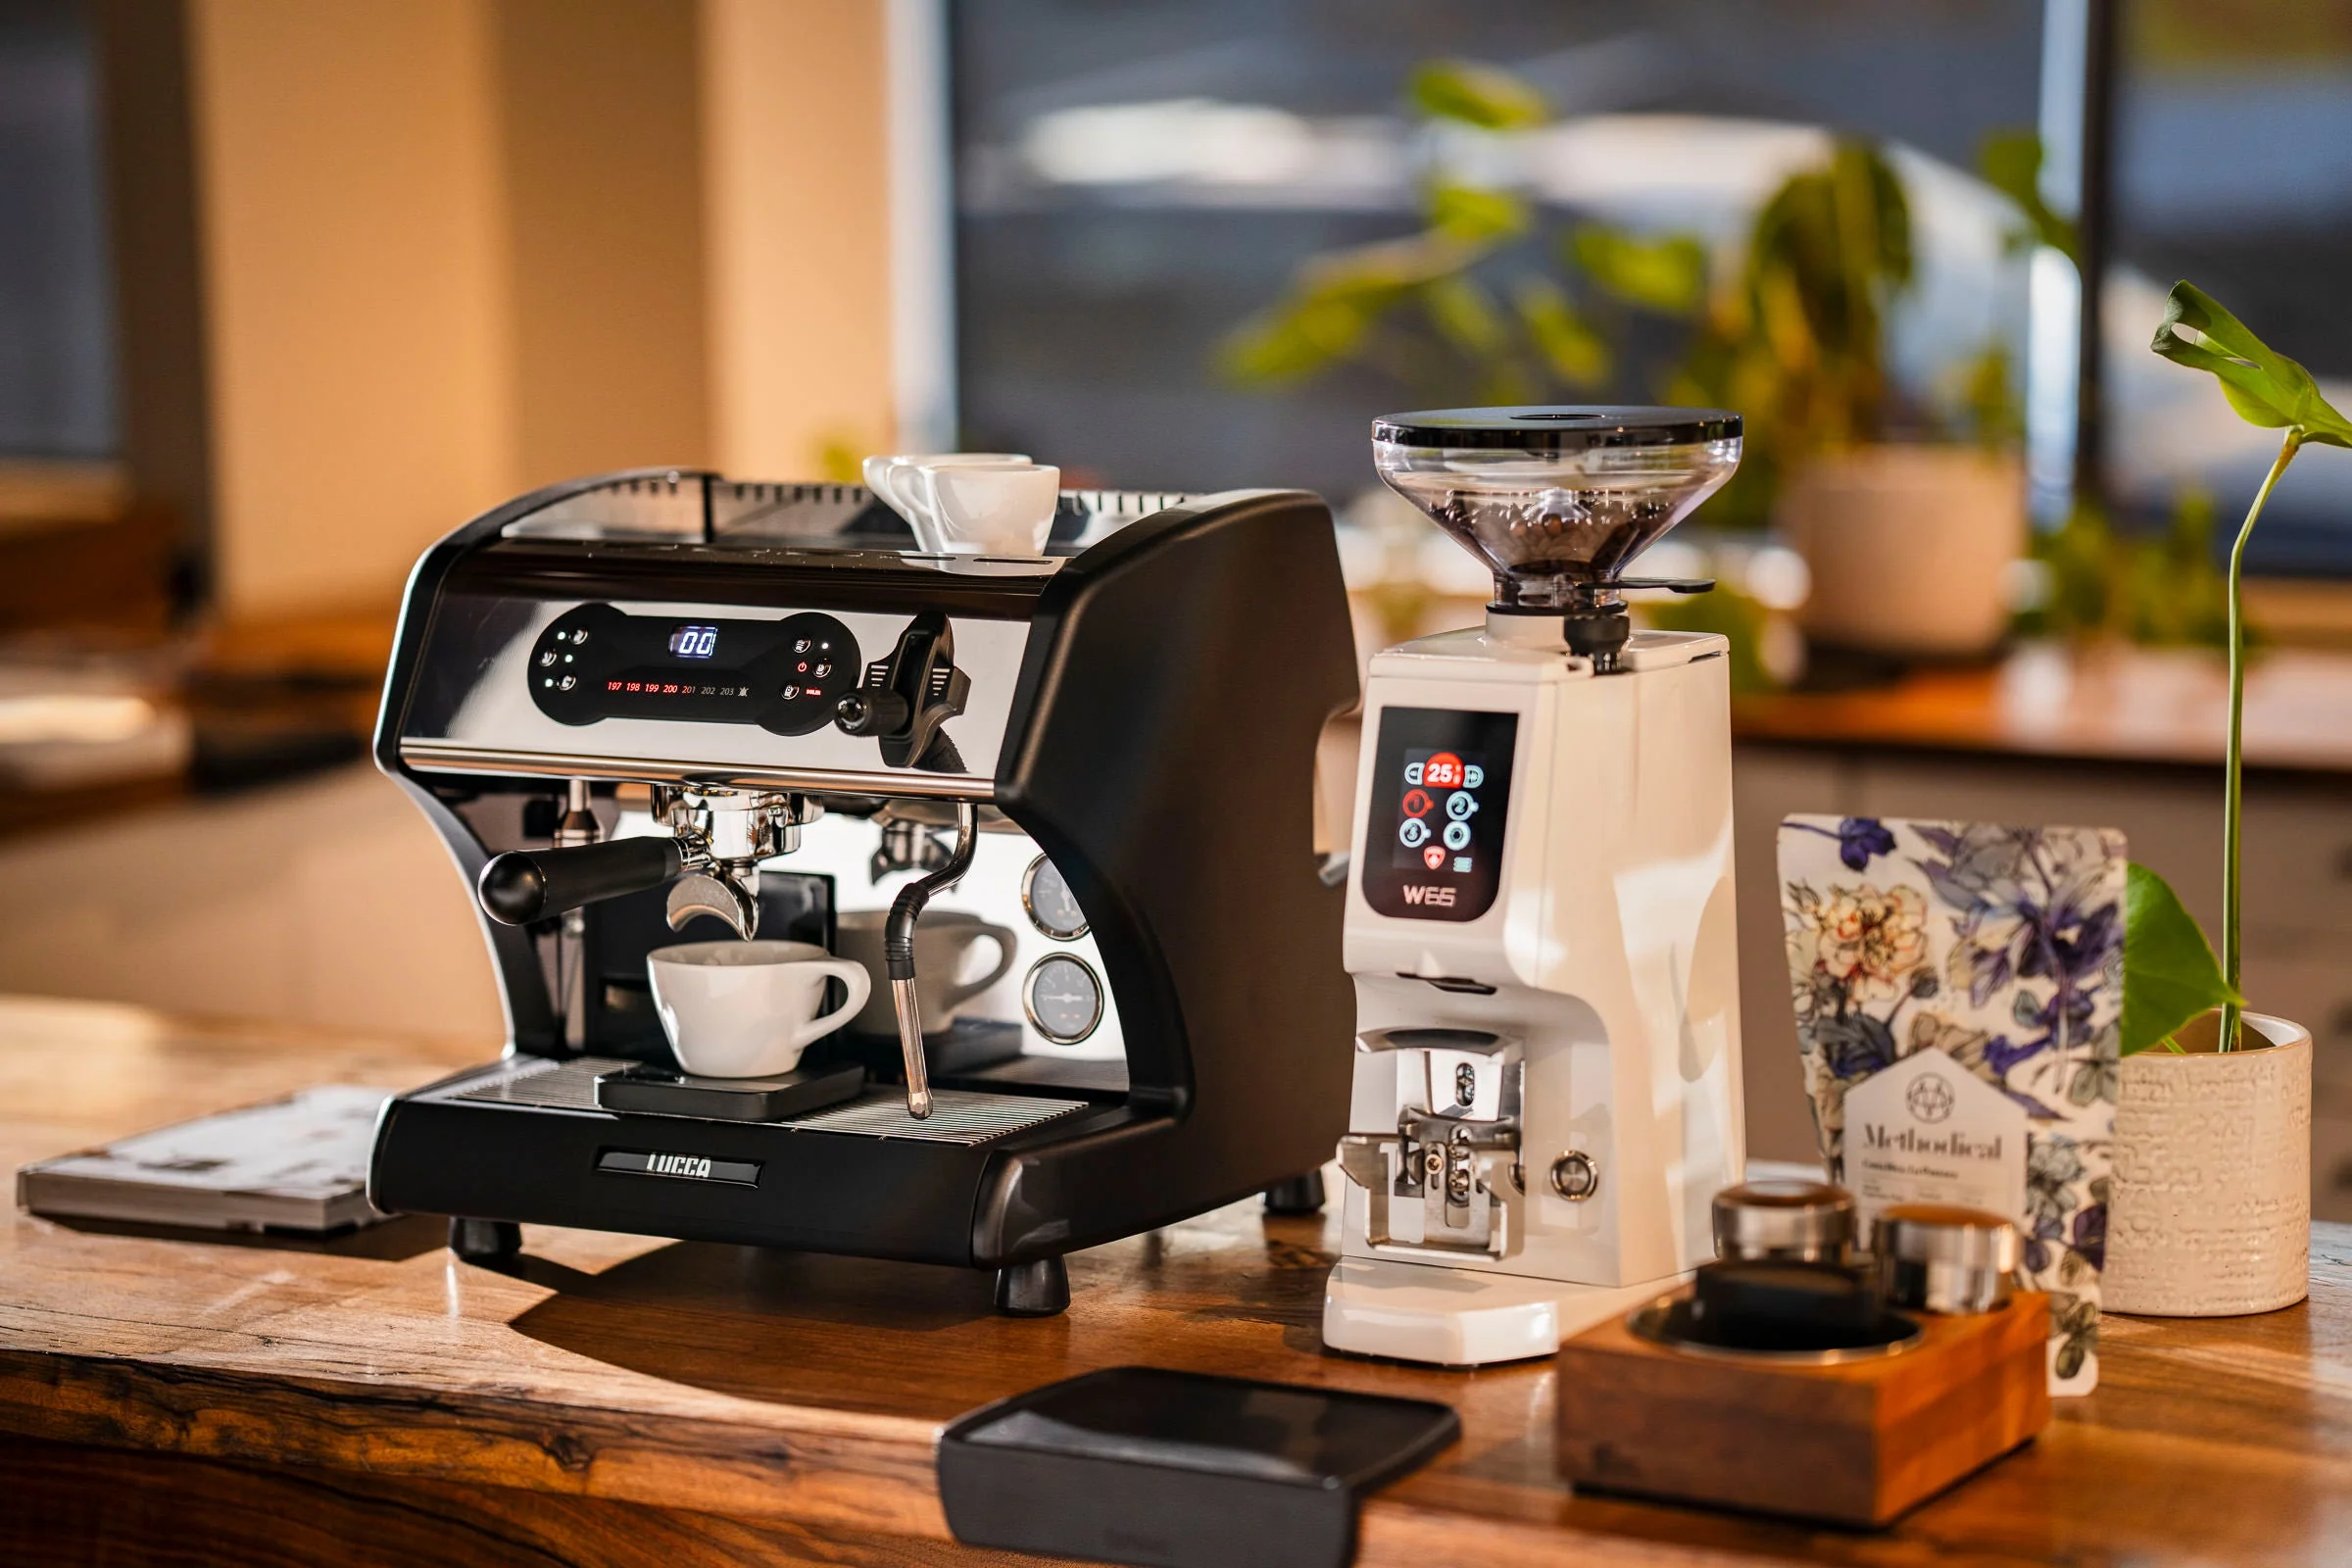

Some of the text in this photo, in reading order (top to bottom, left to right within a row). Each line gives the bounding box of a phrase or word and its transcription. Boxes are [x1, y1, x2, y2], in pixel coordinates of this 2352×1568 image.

[679, 631, 713, 655] 00
[608, 681, 734, 696] 197 198 199 200 201 202 203
[1863, 1122, 2002, 1159] Methodical
[646, 1153, 711, 1178] LUCCA
